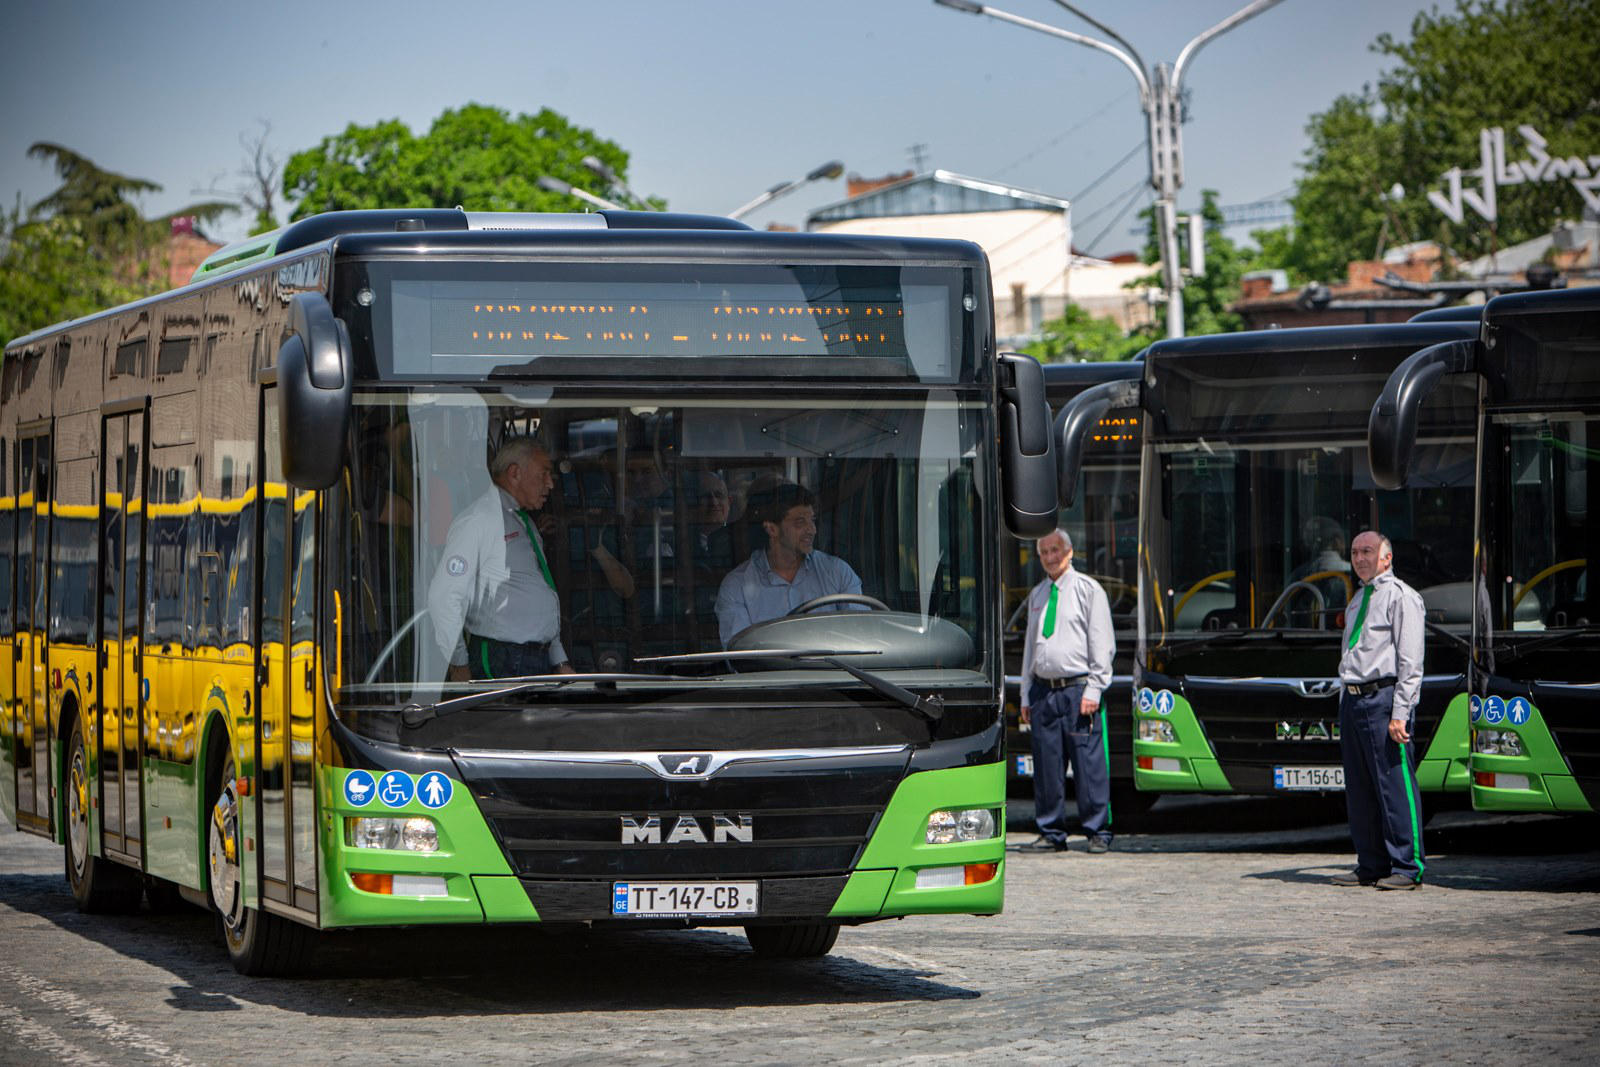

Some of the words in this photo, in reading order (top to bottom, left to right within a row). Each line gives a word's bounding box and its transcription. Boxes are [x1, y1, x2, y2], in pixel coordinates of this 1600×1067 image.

[1285, 769, 1342, 785] TT-156-C
[620, 814, 753, 844] MAN
[615, 900, 627, 910] GE
[632, 887, 739, 910] TT-147-CB
